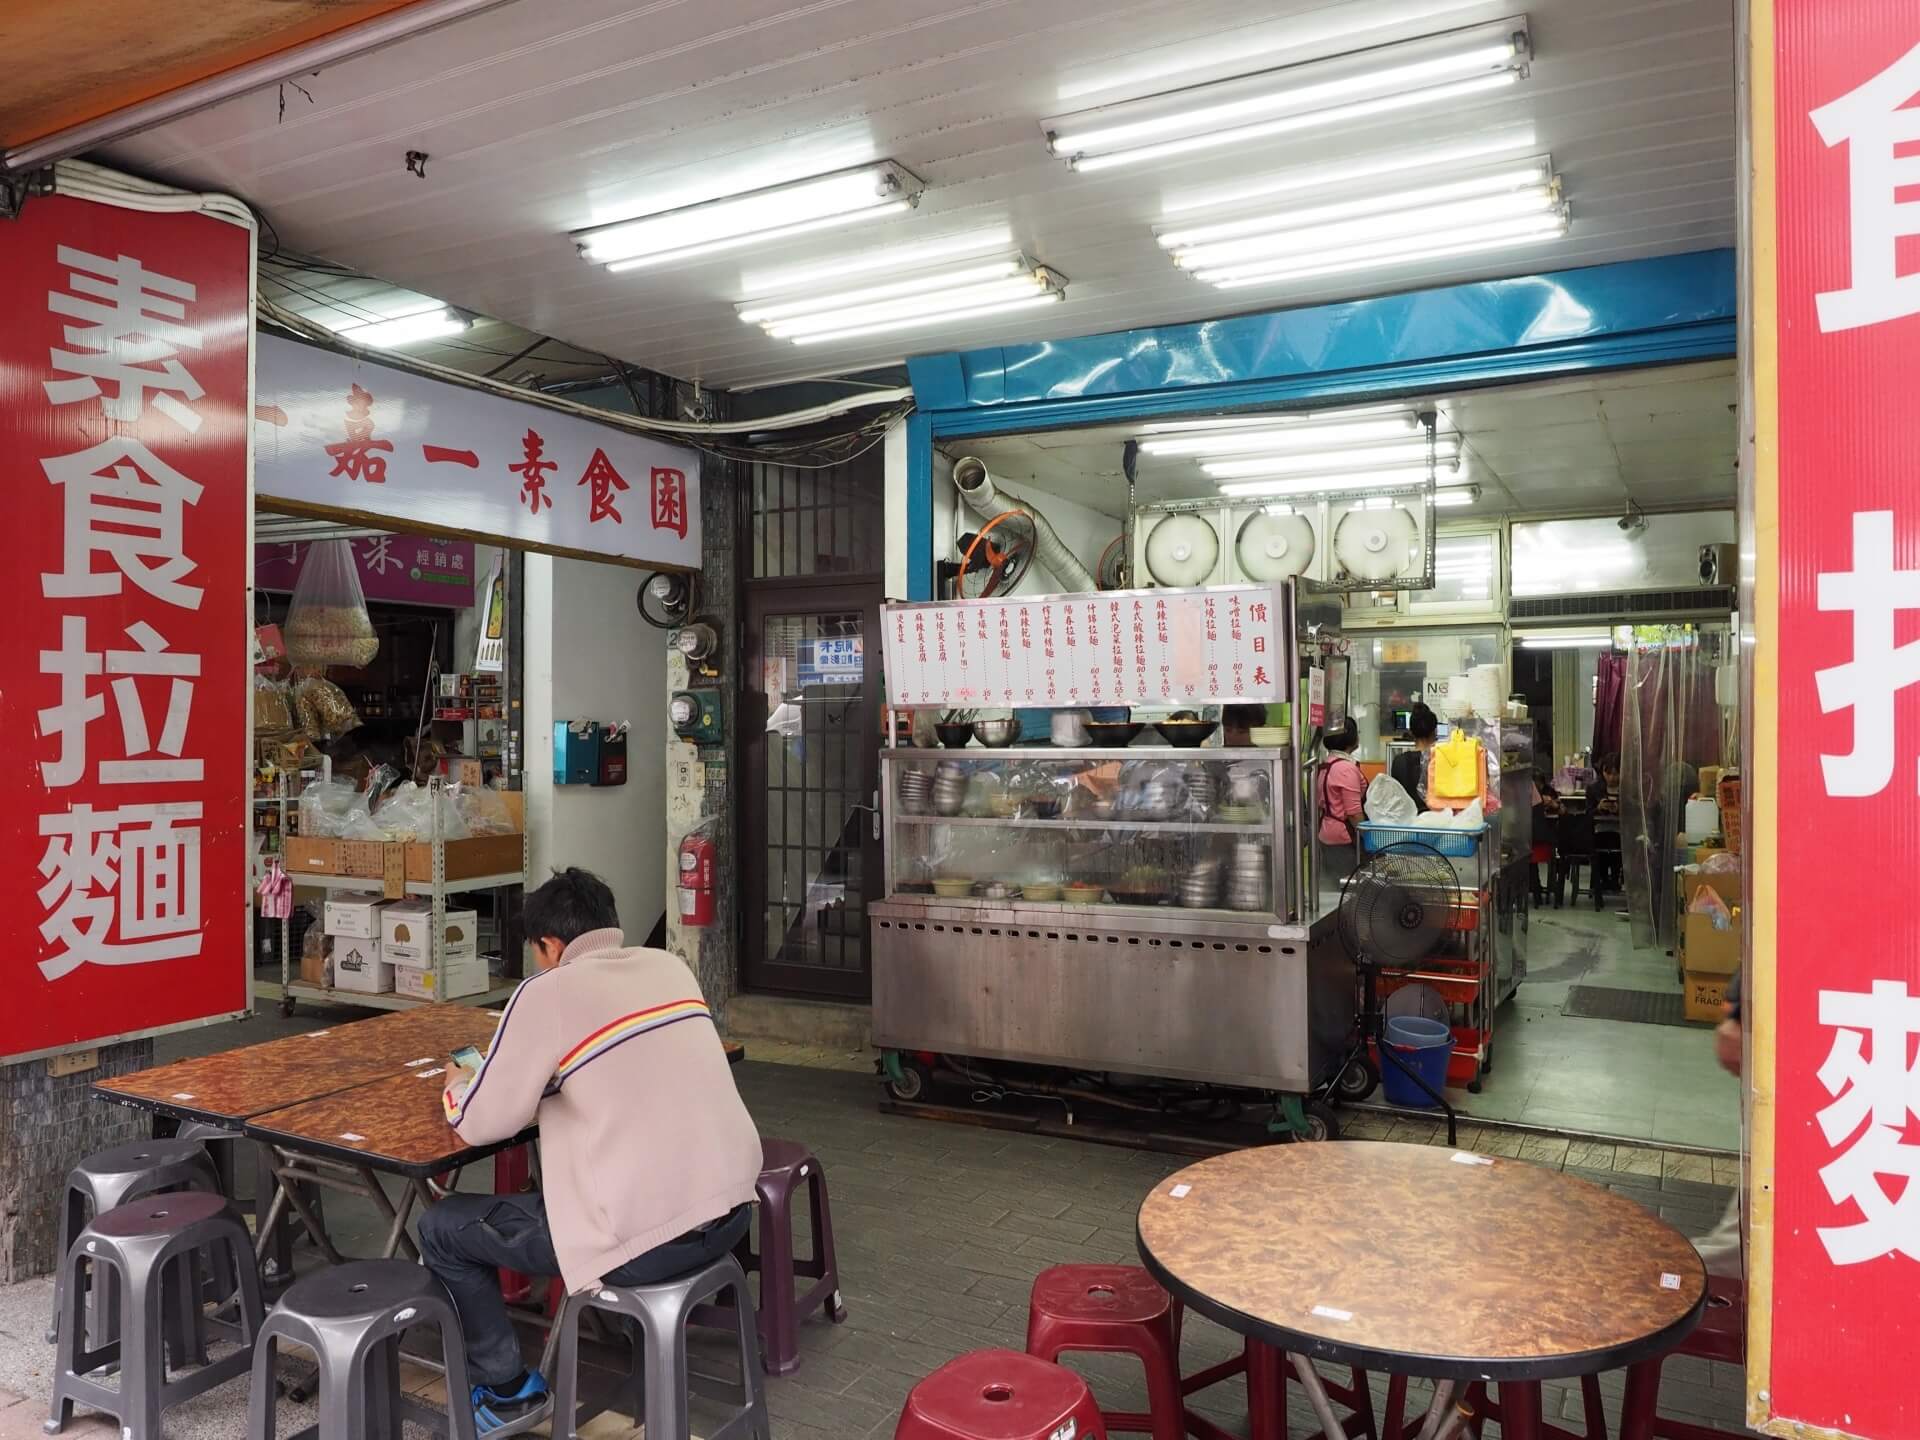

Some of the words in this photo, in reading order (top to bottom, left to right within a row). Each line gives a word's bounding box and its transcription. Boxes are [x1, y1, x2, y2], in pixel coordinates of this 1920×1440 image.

[416, 549, 464, 570] 經銷處
[36, 243, 207, 982] 素食拉麵
[1249, 603, 1271, 685] 價目表
[1695, 996, 1722, 1007] FRAGI
